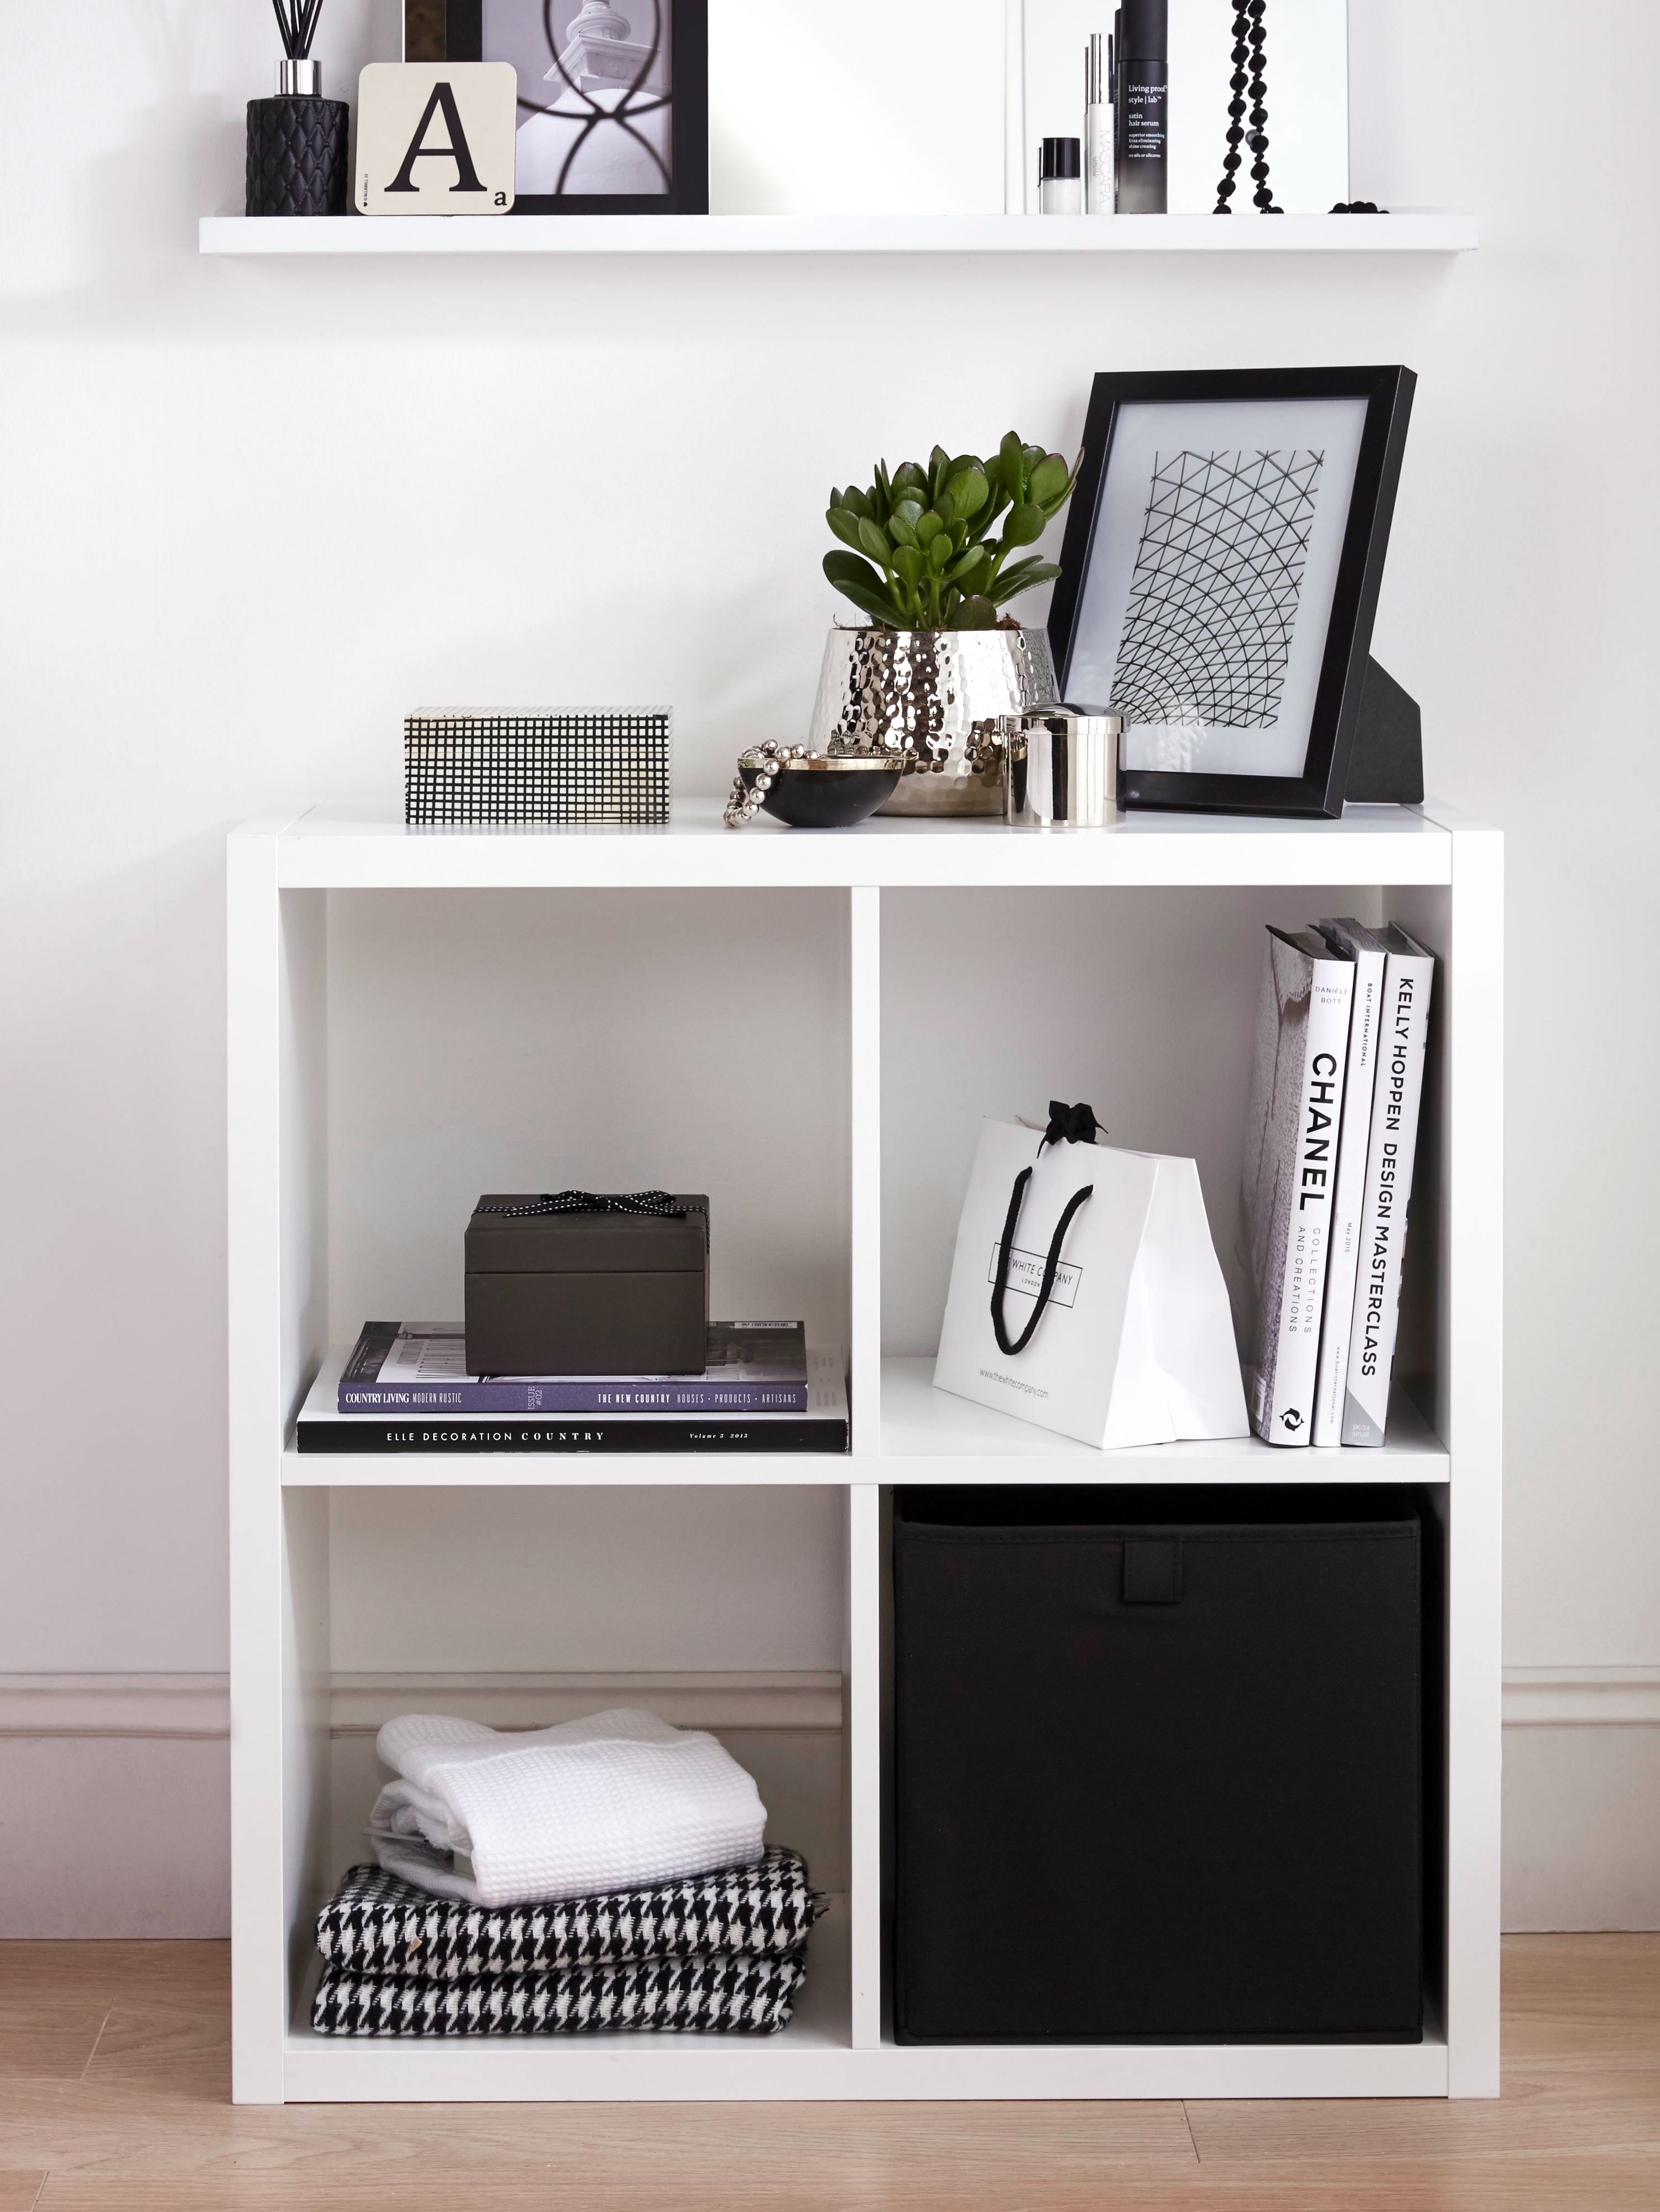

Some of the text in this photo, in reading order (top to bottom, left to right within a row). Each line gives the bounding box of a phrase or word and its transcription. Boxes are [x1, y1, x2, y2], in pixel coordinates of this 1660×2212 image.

[1128, 85, 1149, 93] Living
[1128, 96, 1143, 105] style
[384, 82, 488, 192] A
[1099, 129, 1111, 204] MASCARA
[494, 191, 507, 206] a
[1315, 985, 1348, 994] DANIÈLE
[1360, 1005, 1371, 1067] INTERNATIONAL
[1299, 1053, 1338, 1211] CHANEL
[1361, 978, 1414, 1376] KELLY HOPPEN DESIGN MASTERCLASS
[1012, 1258, 1035, 1274] WHITE
[1021, 1278, 1040, 1287] LONDON
[1289, 1225, 1306, 1332] AND CREATIONS
[1304, 1228, 1321, 1333] COLLECTIONS
[980, 1369, 1049, 1399] www.thewhitecompany.com
[1330, 1346, 1340, 1425] www.boatinternational.com
[345, 1392, 462, 1404] COUNTRY LIVING MODERN RUSTIC
[597, 1394, 796, 1404] THE NEW COUNTRY HOUSES PRODUCTS ARTISANS
[387, 1433, 414, 1441] ELLE
[423, 1432, 512, 1441] DECORATION
[521, 1432, 603, 1441] COUNTRY
